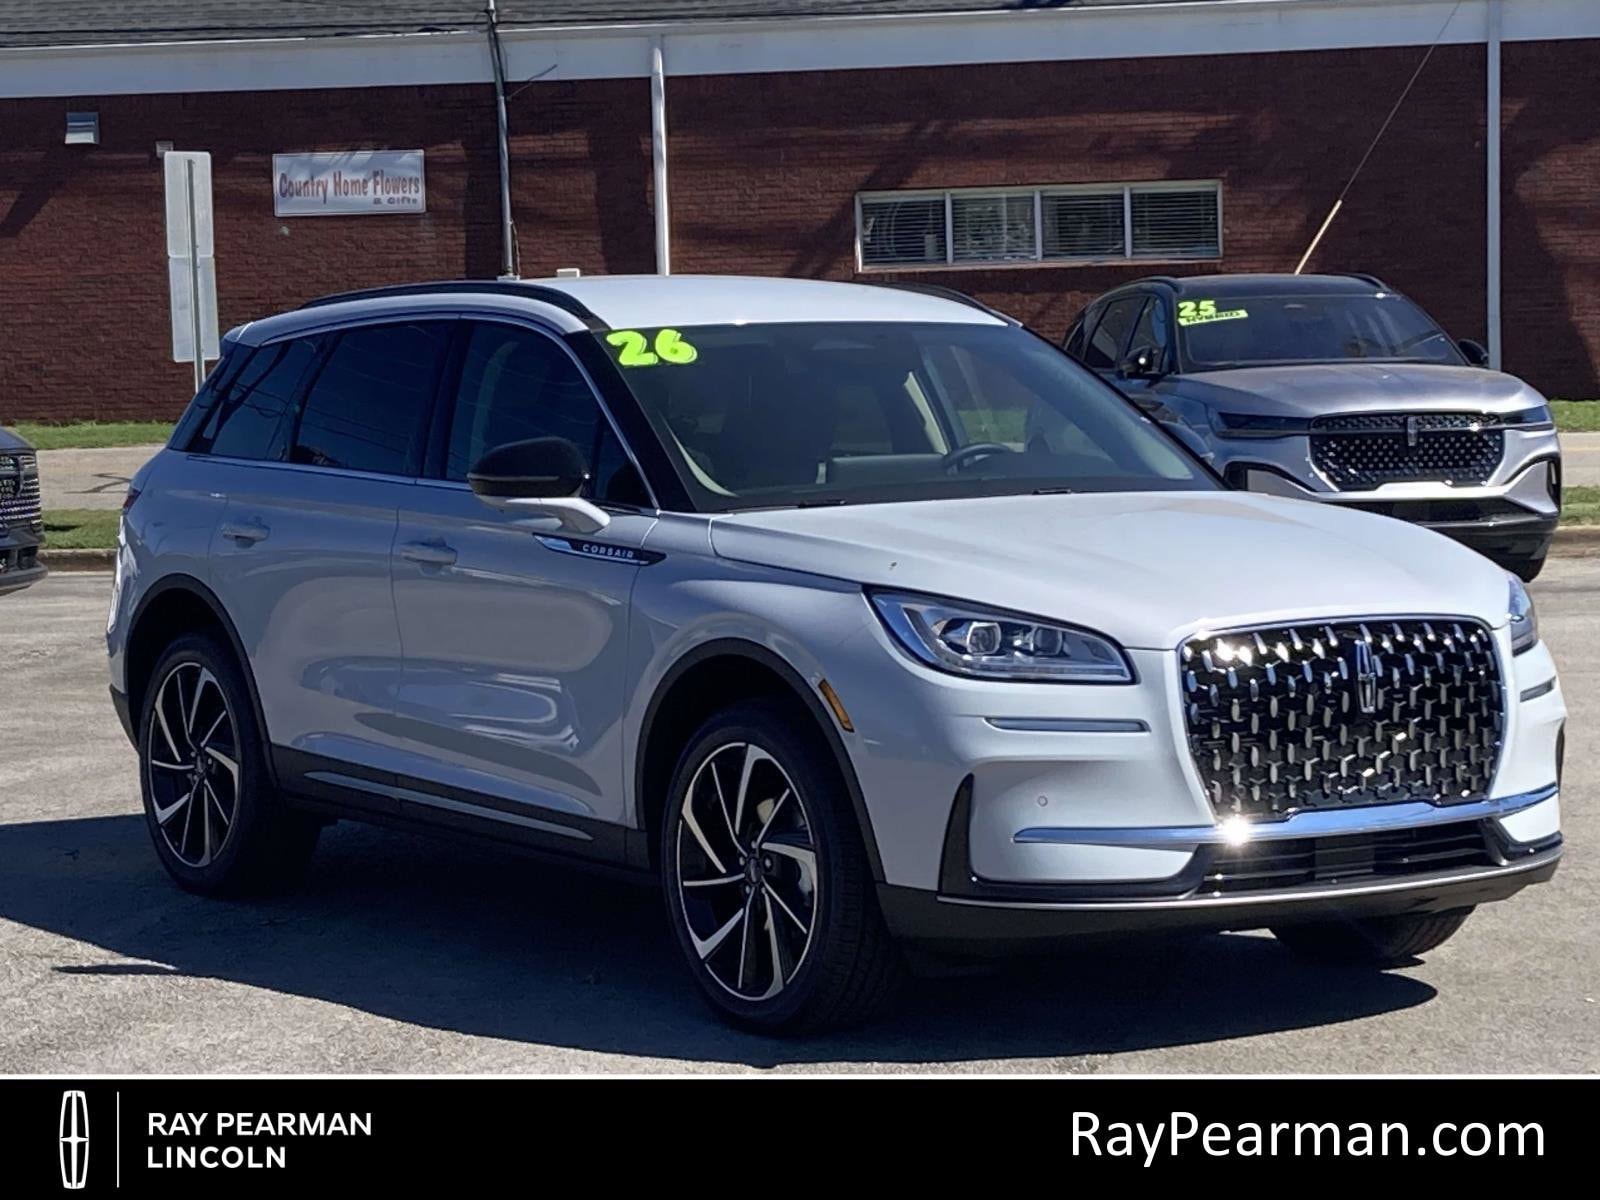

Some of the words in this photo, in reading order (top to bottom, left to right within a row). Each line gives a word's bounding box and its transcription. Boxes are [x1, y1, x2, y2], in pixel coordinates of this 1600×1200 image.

[279, 172, 329, 204] Country
[333, 170, 369, 197] Home
[372, 169, 420, 196] Flowers
[1178, 300, 1217, 318] 25
[606, 328, 698, 366] 26
[582, 543, 634, 558] CORSAIR
